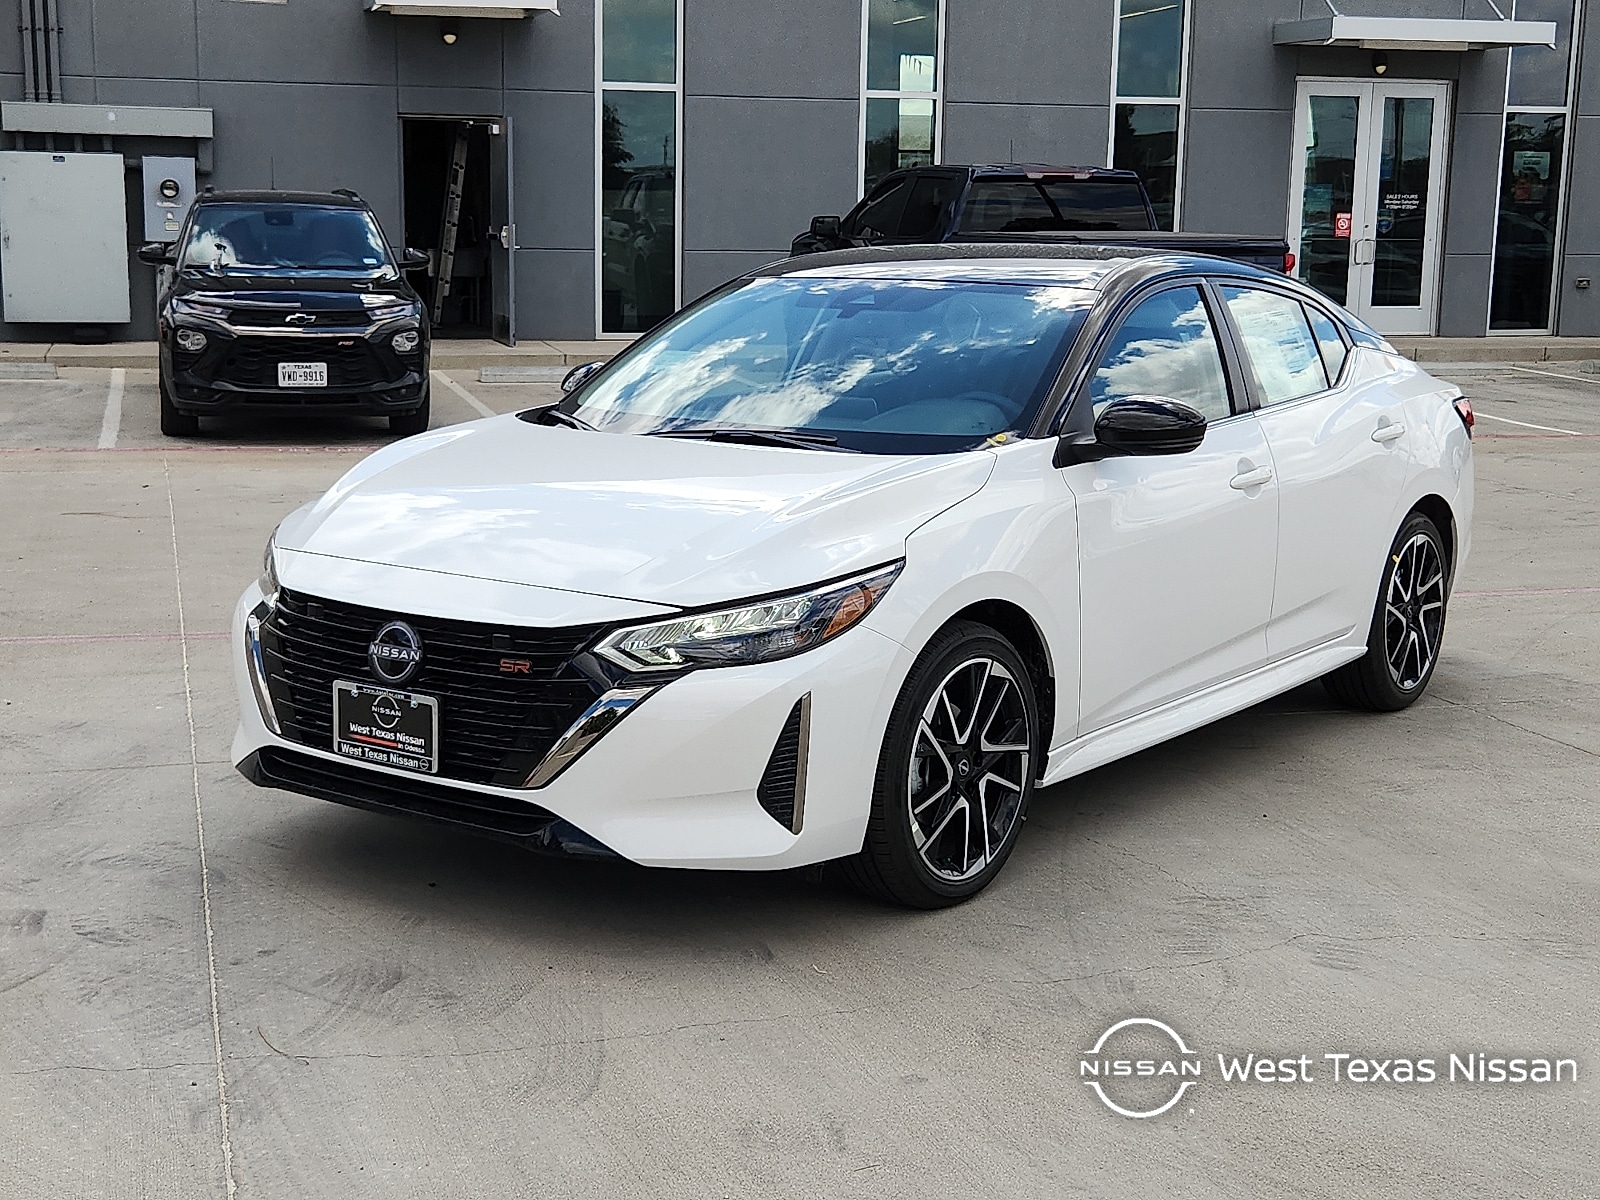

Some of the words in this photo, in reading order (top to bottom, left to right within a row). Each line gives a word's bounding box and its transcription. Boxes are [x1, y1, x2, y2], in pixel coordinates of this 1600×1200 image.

[370, 643, 421, 662] NISSAN
[499, 657, 533, 674] SR
[371, 706, 402, 717] NISSAN
[349, 722, 370, 735] West
[371, 727, 395, 739] Texas
[396, 732, 425, 746] Nissan
[340, 742, 362, 757] West
[364, 748, 388, 762] Texas
[389, 753, 419, 768] Nissan
